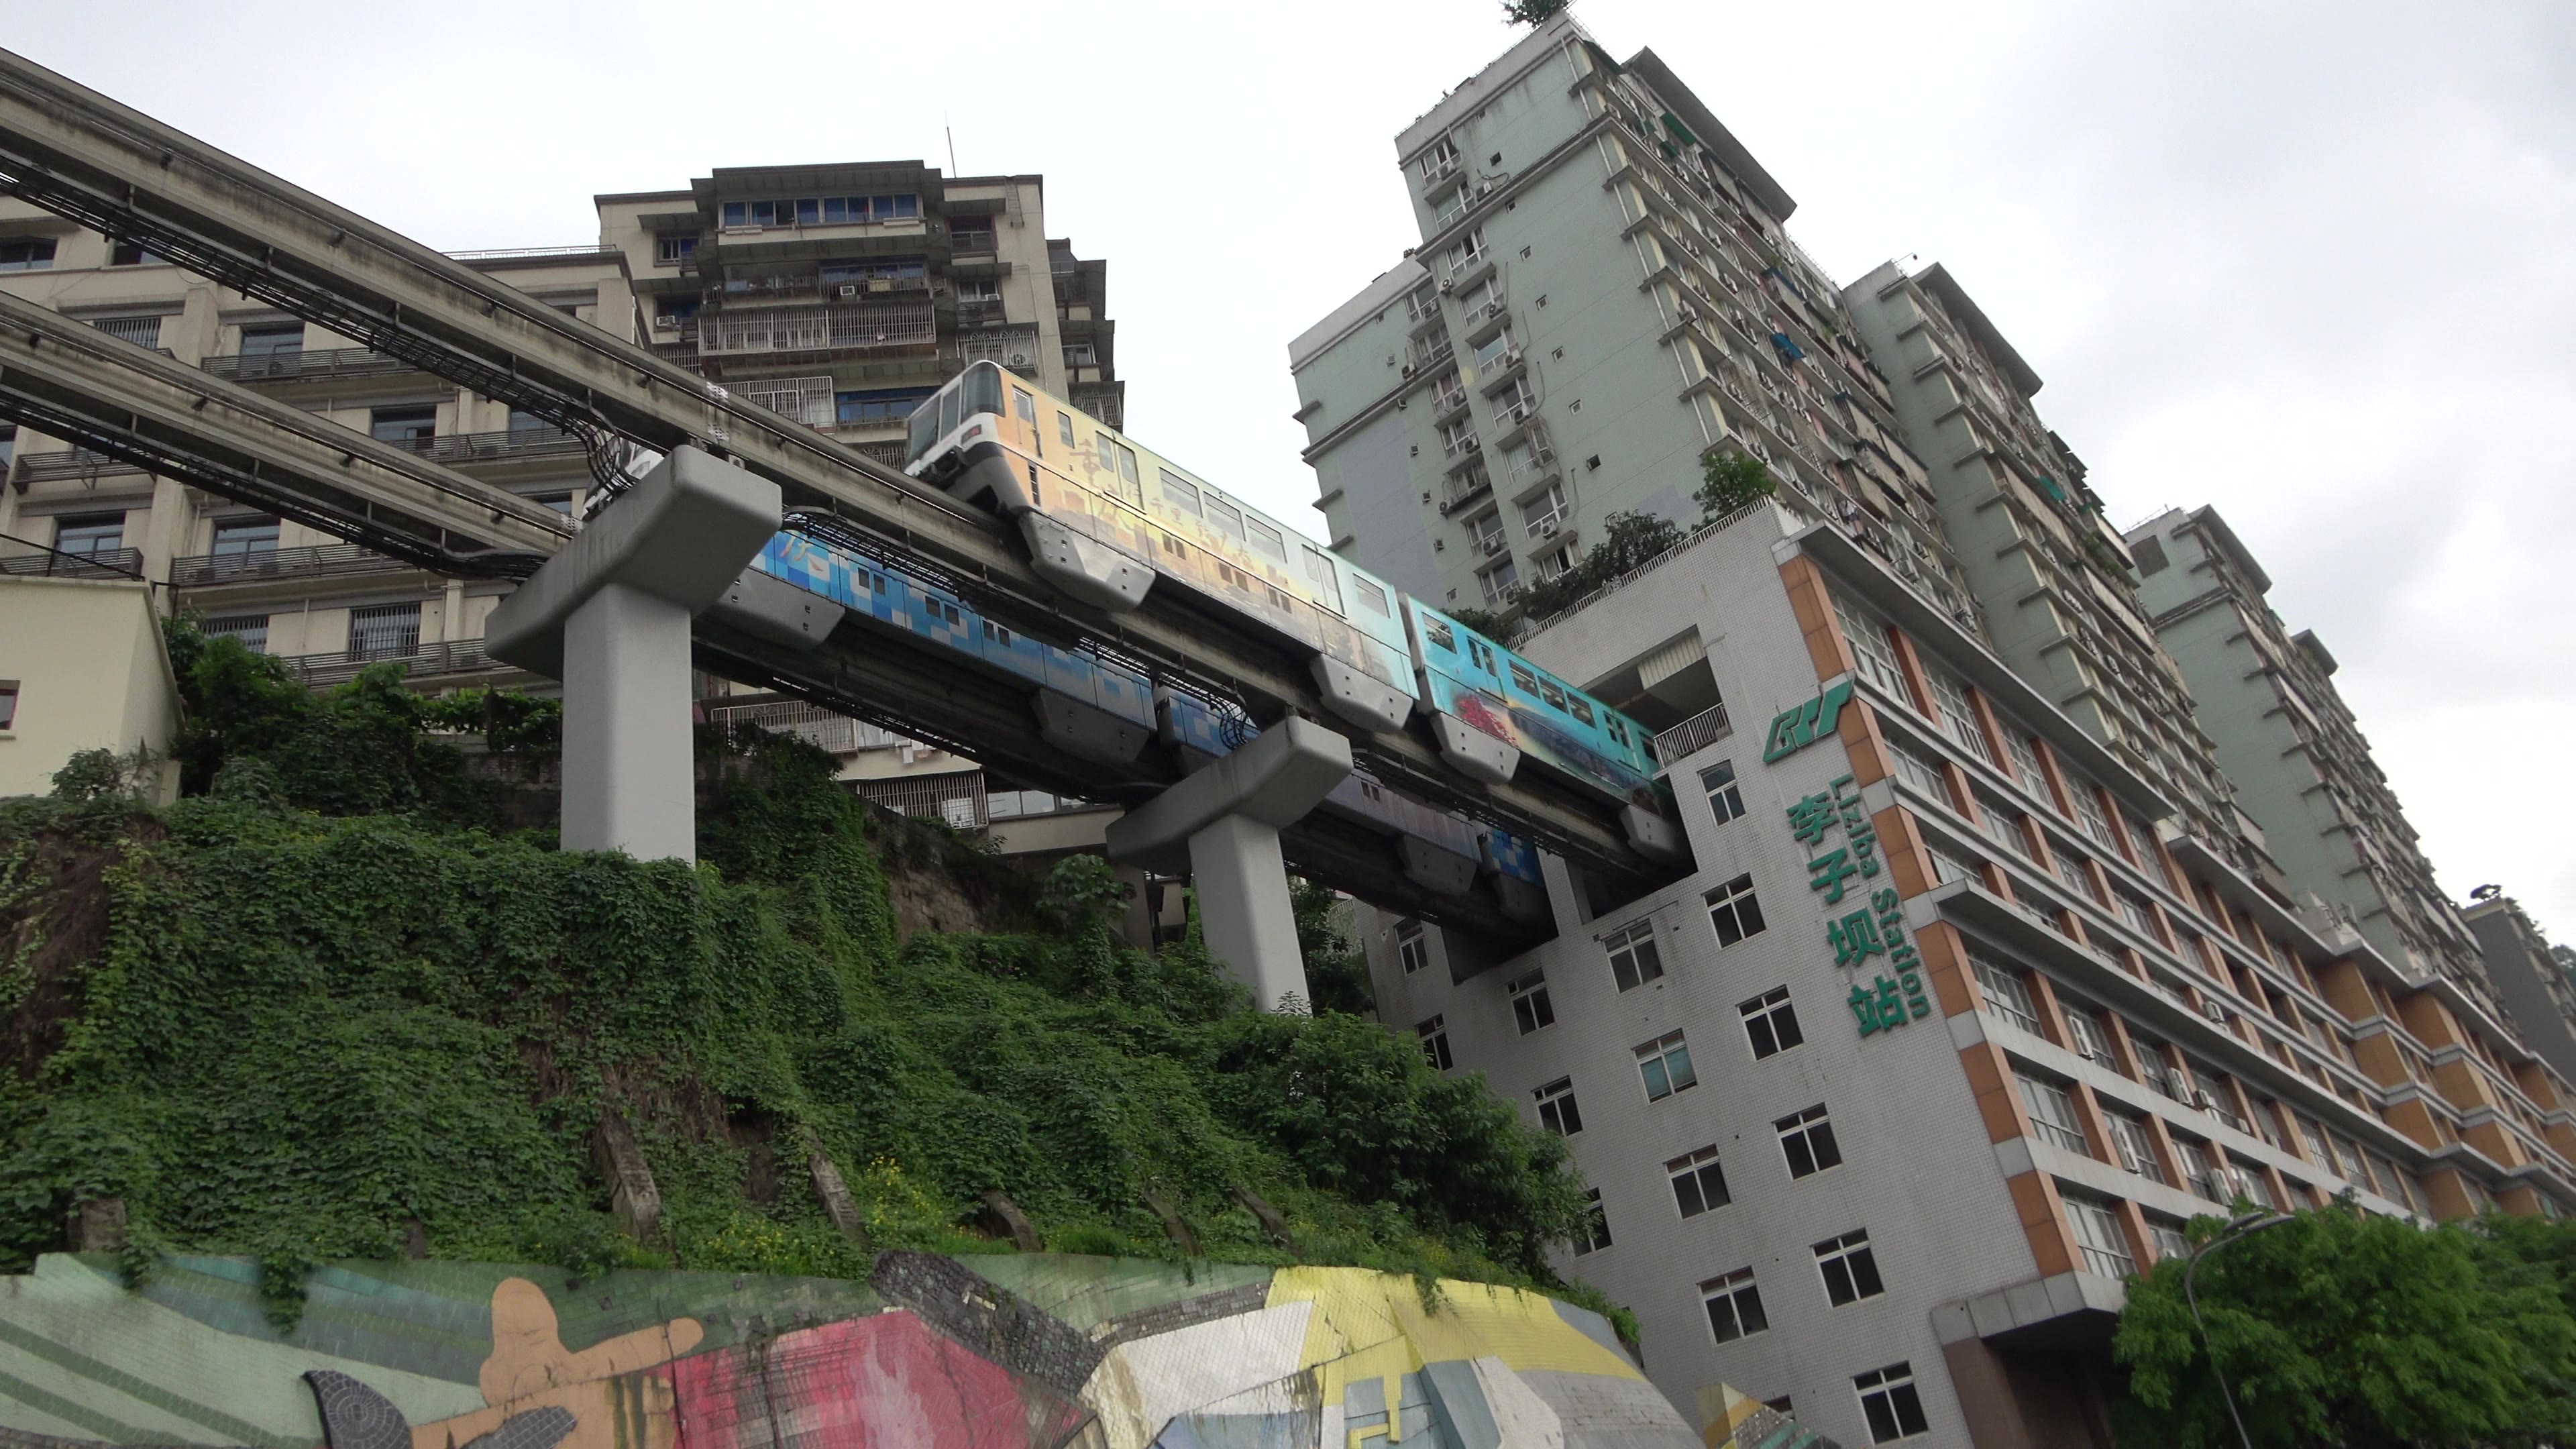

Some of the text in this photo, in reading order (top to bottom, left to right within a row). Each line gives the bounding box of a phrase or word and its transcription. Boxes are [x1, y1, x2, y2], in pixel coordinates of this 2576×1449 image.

[1786, 790, 1909, 1038] 李子坝站
[1828, 773, 1931, 1019] Liziba Station
